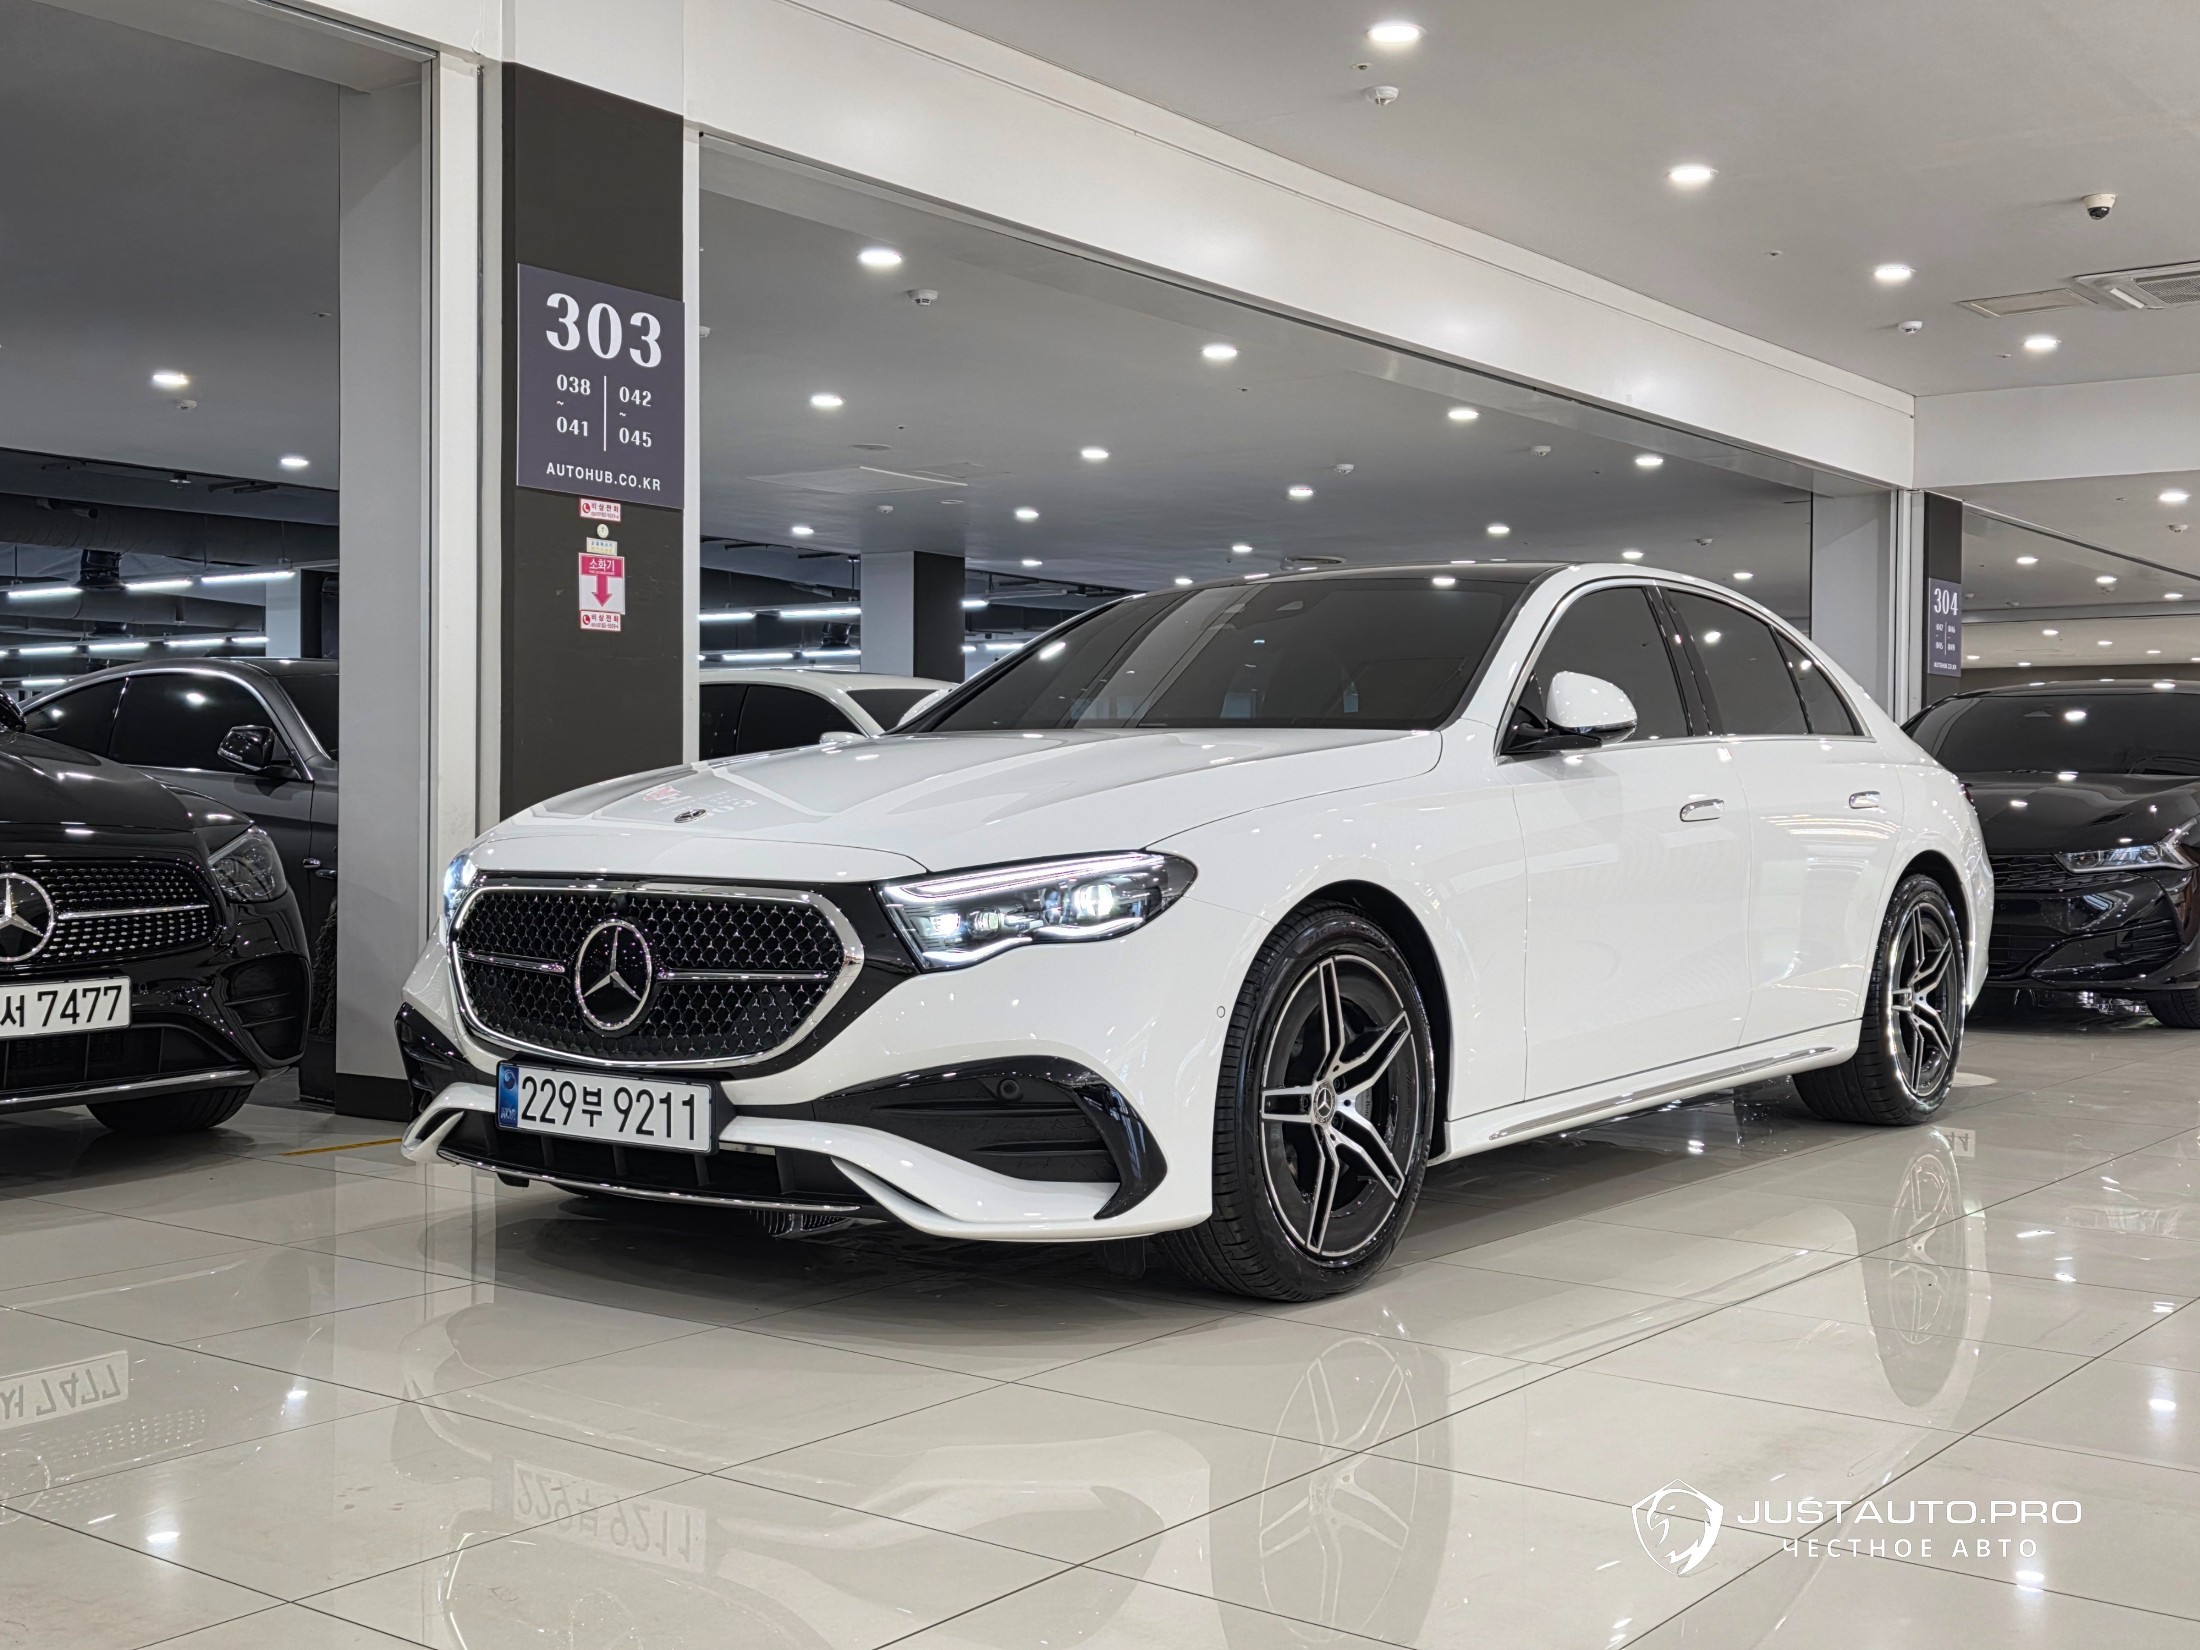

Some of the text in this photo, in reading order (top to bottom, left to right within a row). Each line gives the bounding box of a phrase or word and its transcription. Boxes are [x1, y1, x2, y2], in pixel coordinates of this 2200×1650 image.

[545, 292, 663, 368] 303
[556, 374, 591, 395] 038
[619, 386, 652, 407] 042
[556, 416, 589, 437] 041
[619, 427, 652, 448] 045
[546, 462, 661, 491] AUTOHUB.CO.KR
[589, 559, 615, 572] 소화기
[1933, 588, 1959, 616] 304
[0, 985, 122, 1027] 서 7477
[521, 1075, 695, 1141] 229부 9211
